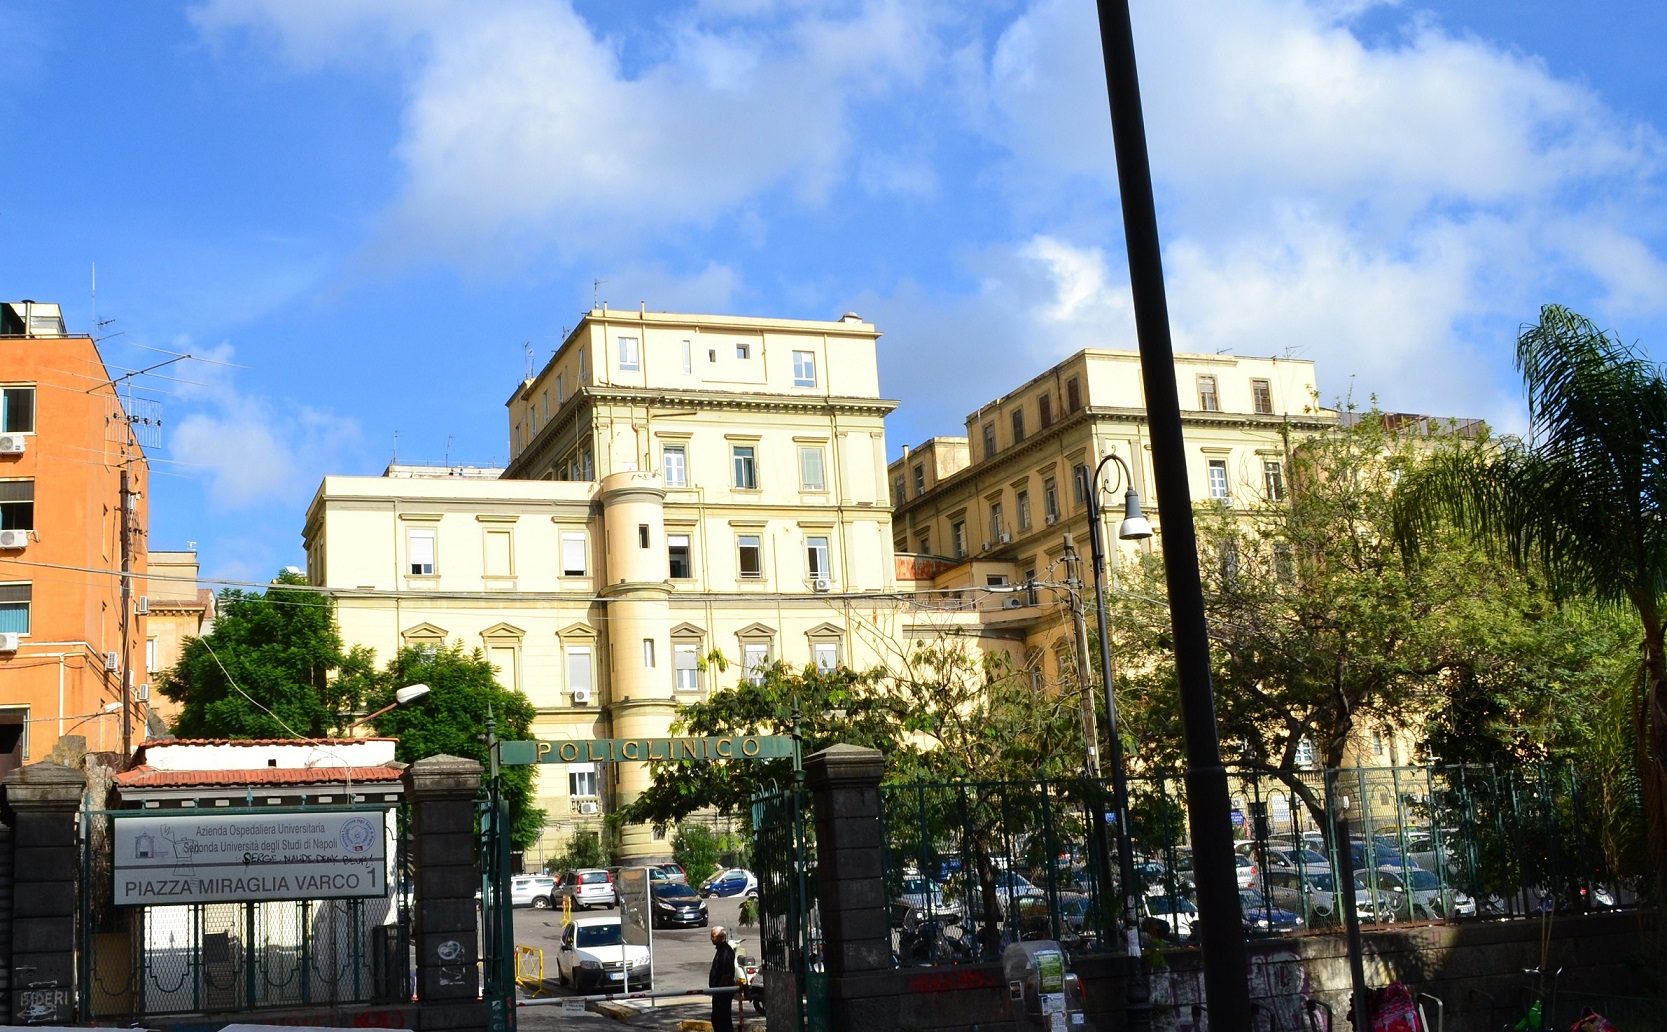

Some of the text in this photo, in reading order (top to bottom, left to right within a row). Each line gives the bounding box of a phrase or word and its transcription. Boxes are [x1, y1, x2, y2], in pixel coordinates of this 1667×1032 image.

[535, 738, 760, 763] POLICLINICO
[196, 822, 325, 838] Azienda Ospedaliera Universitaria
[220, 840, 259, 852] Università
[261, 839, 280, 853] degli
[282, 838, 302, 850] Studi
[304, 838, 311, 850] di
[312, 837, 338, 851] Napoli
[125, 867, 377, 897] PIAZZA MIRAGLIA VARCO 1
